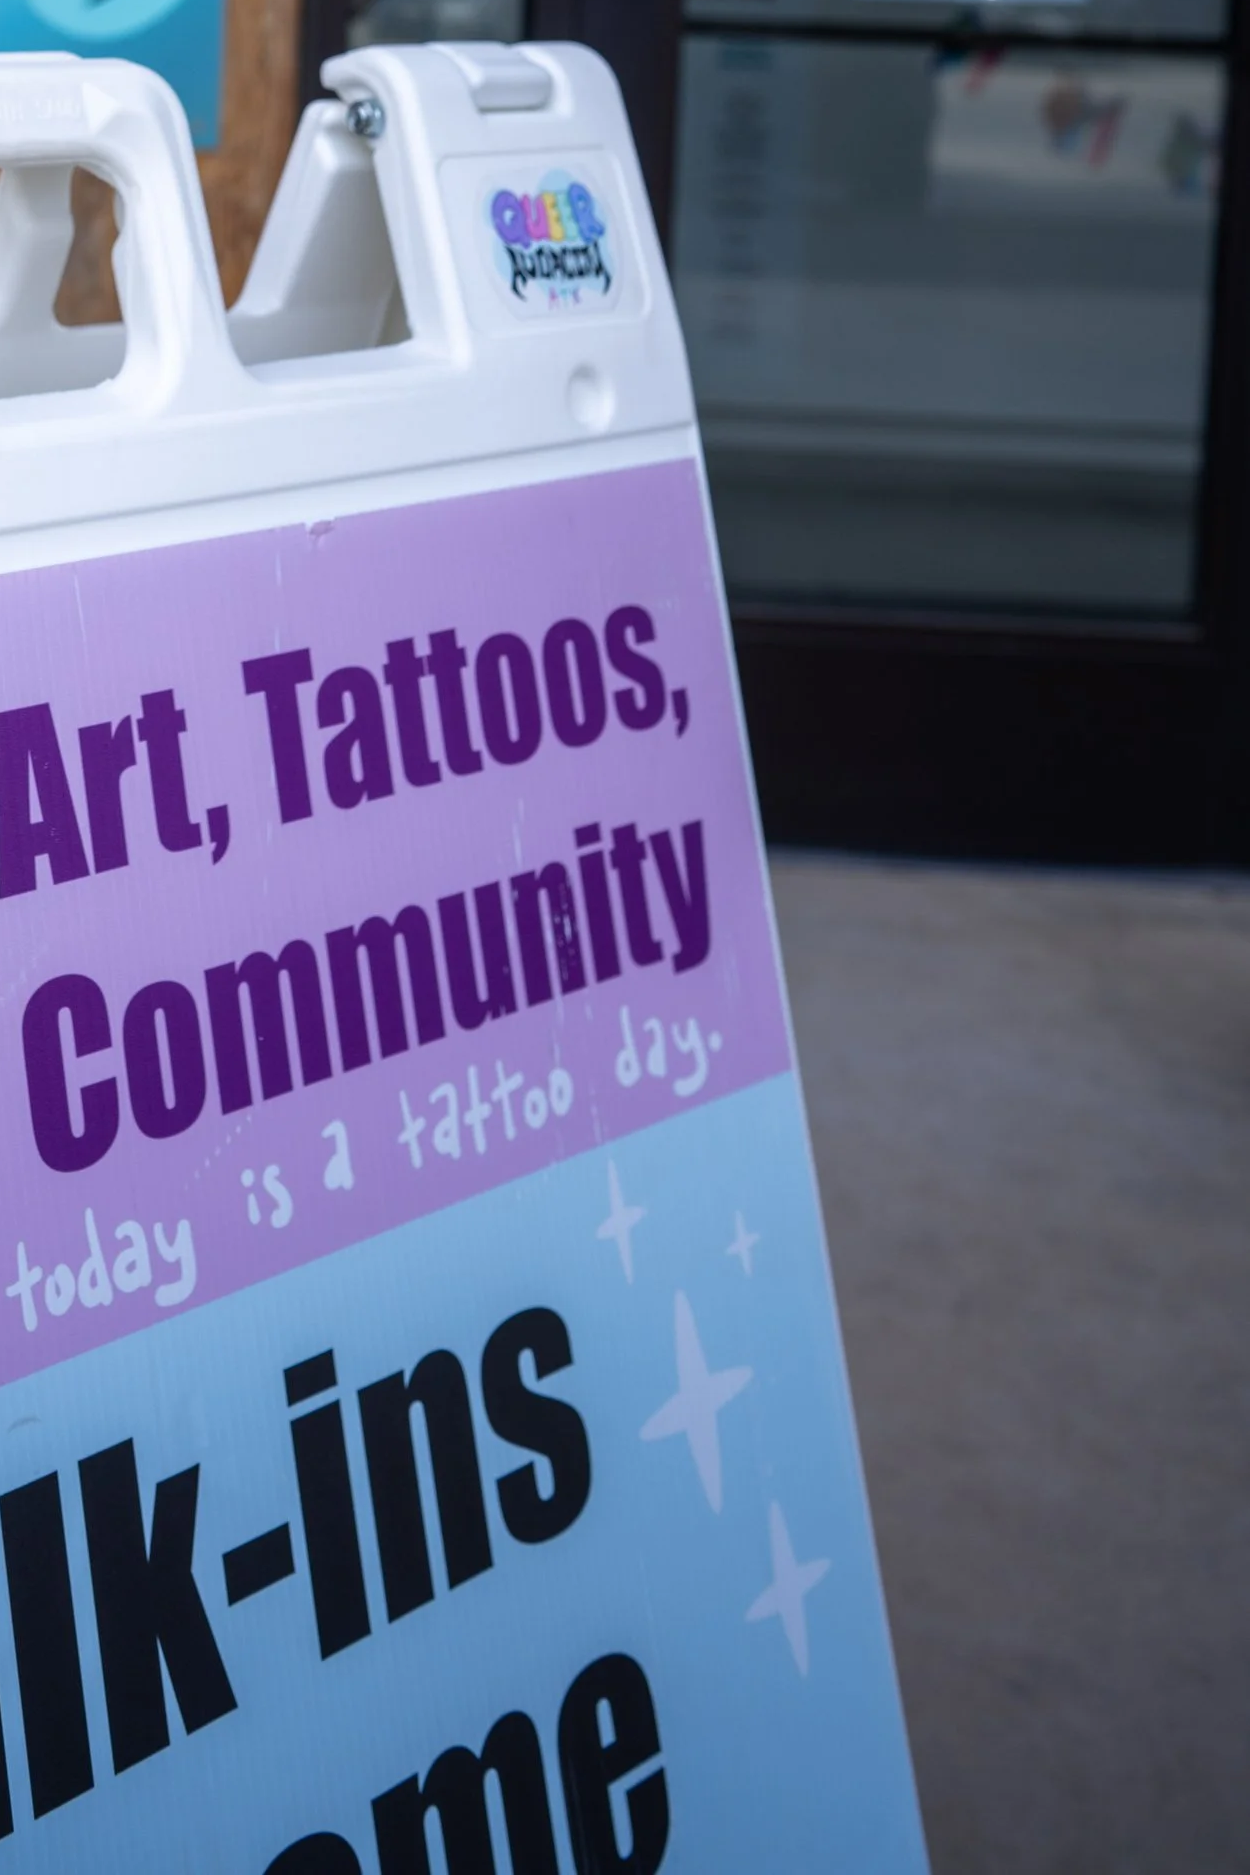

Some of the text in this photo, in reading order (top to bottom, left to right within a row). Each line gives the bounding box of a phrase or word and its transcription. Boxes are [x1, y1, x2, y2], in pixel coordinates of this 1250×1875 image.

[491, 182, 605, 249] QUEER
[241, 604, 691, 824] Tattoos,
[21, 819, 711, 1174] Community
[5, 1005, 724, 1331] today is a tattoo day.
